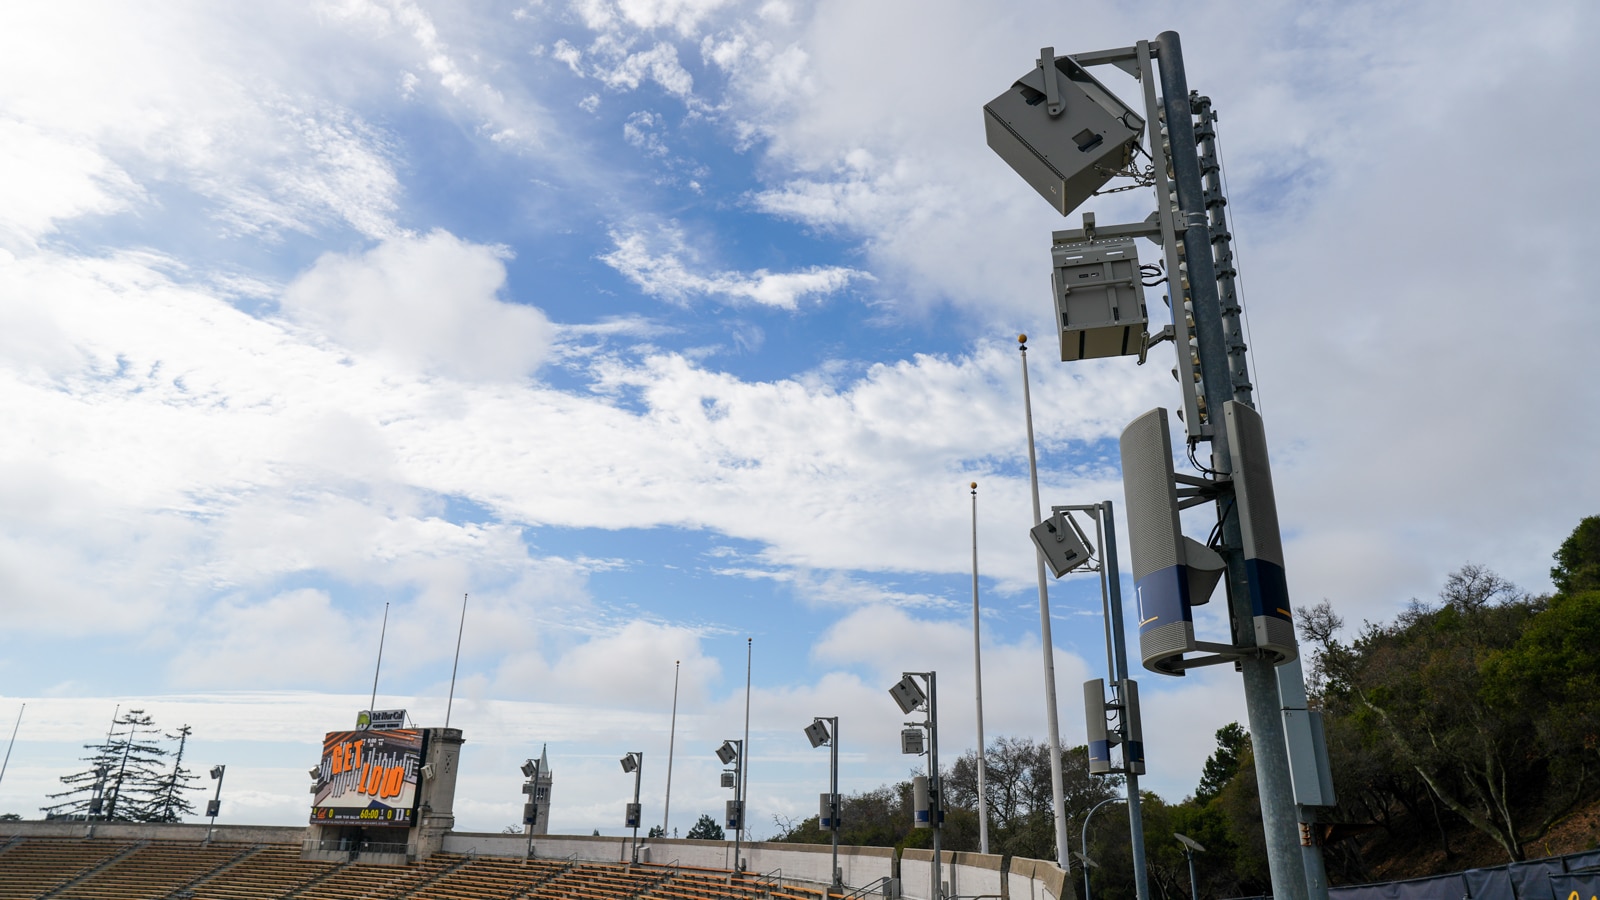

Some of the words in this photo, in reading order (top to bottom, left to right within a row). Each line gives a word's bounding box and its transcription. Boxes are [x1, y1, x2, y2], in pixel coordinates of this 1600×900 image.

[332, 739, 363, 774] GET
[358, 762, 405, 798] LOUD
[360, 809, 379, 819] 60:00
